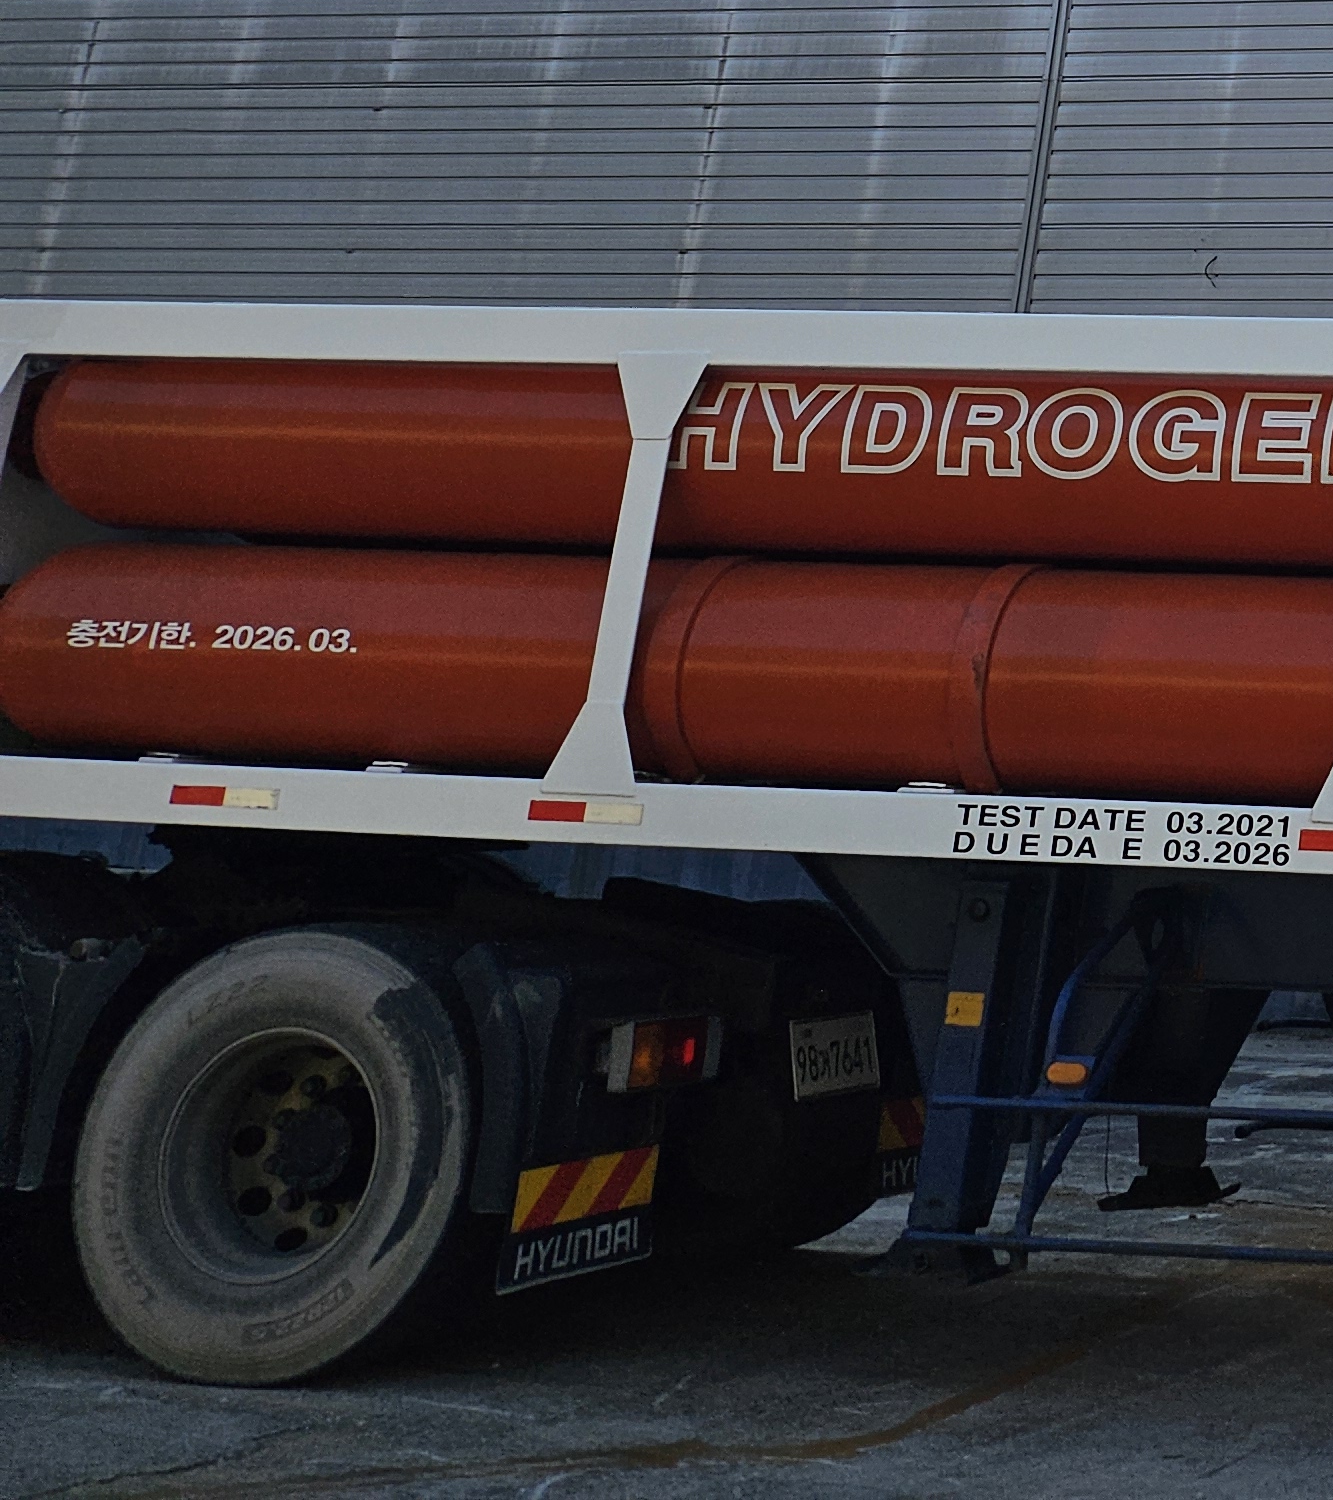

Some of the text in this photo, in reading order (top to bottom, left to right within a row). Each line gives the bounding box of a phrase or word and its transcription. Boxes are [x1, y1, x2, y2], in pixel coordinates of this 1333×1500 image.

[66, 618, 197, 650] 충전기한.
[957, 803, 1290, 838] TEST DATE 03.2021
[1163, 839, 1291, 867] 03.2026
[513, 1216, 640, 1281] HYUNDAI
